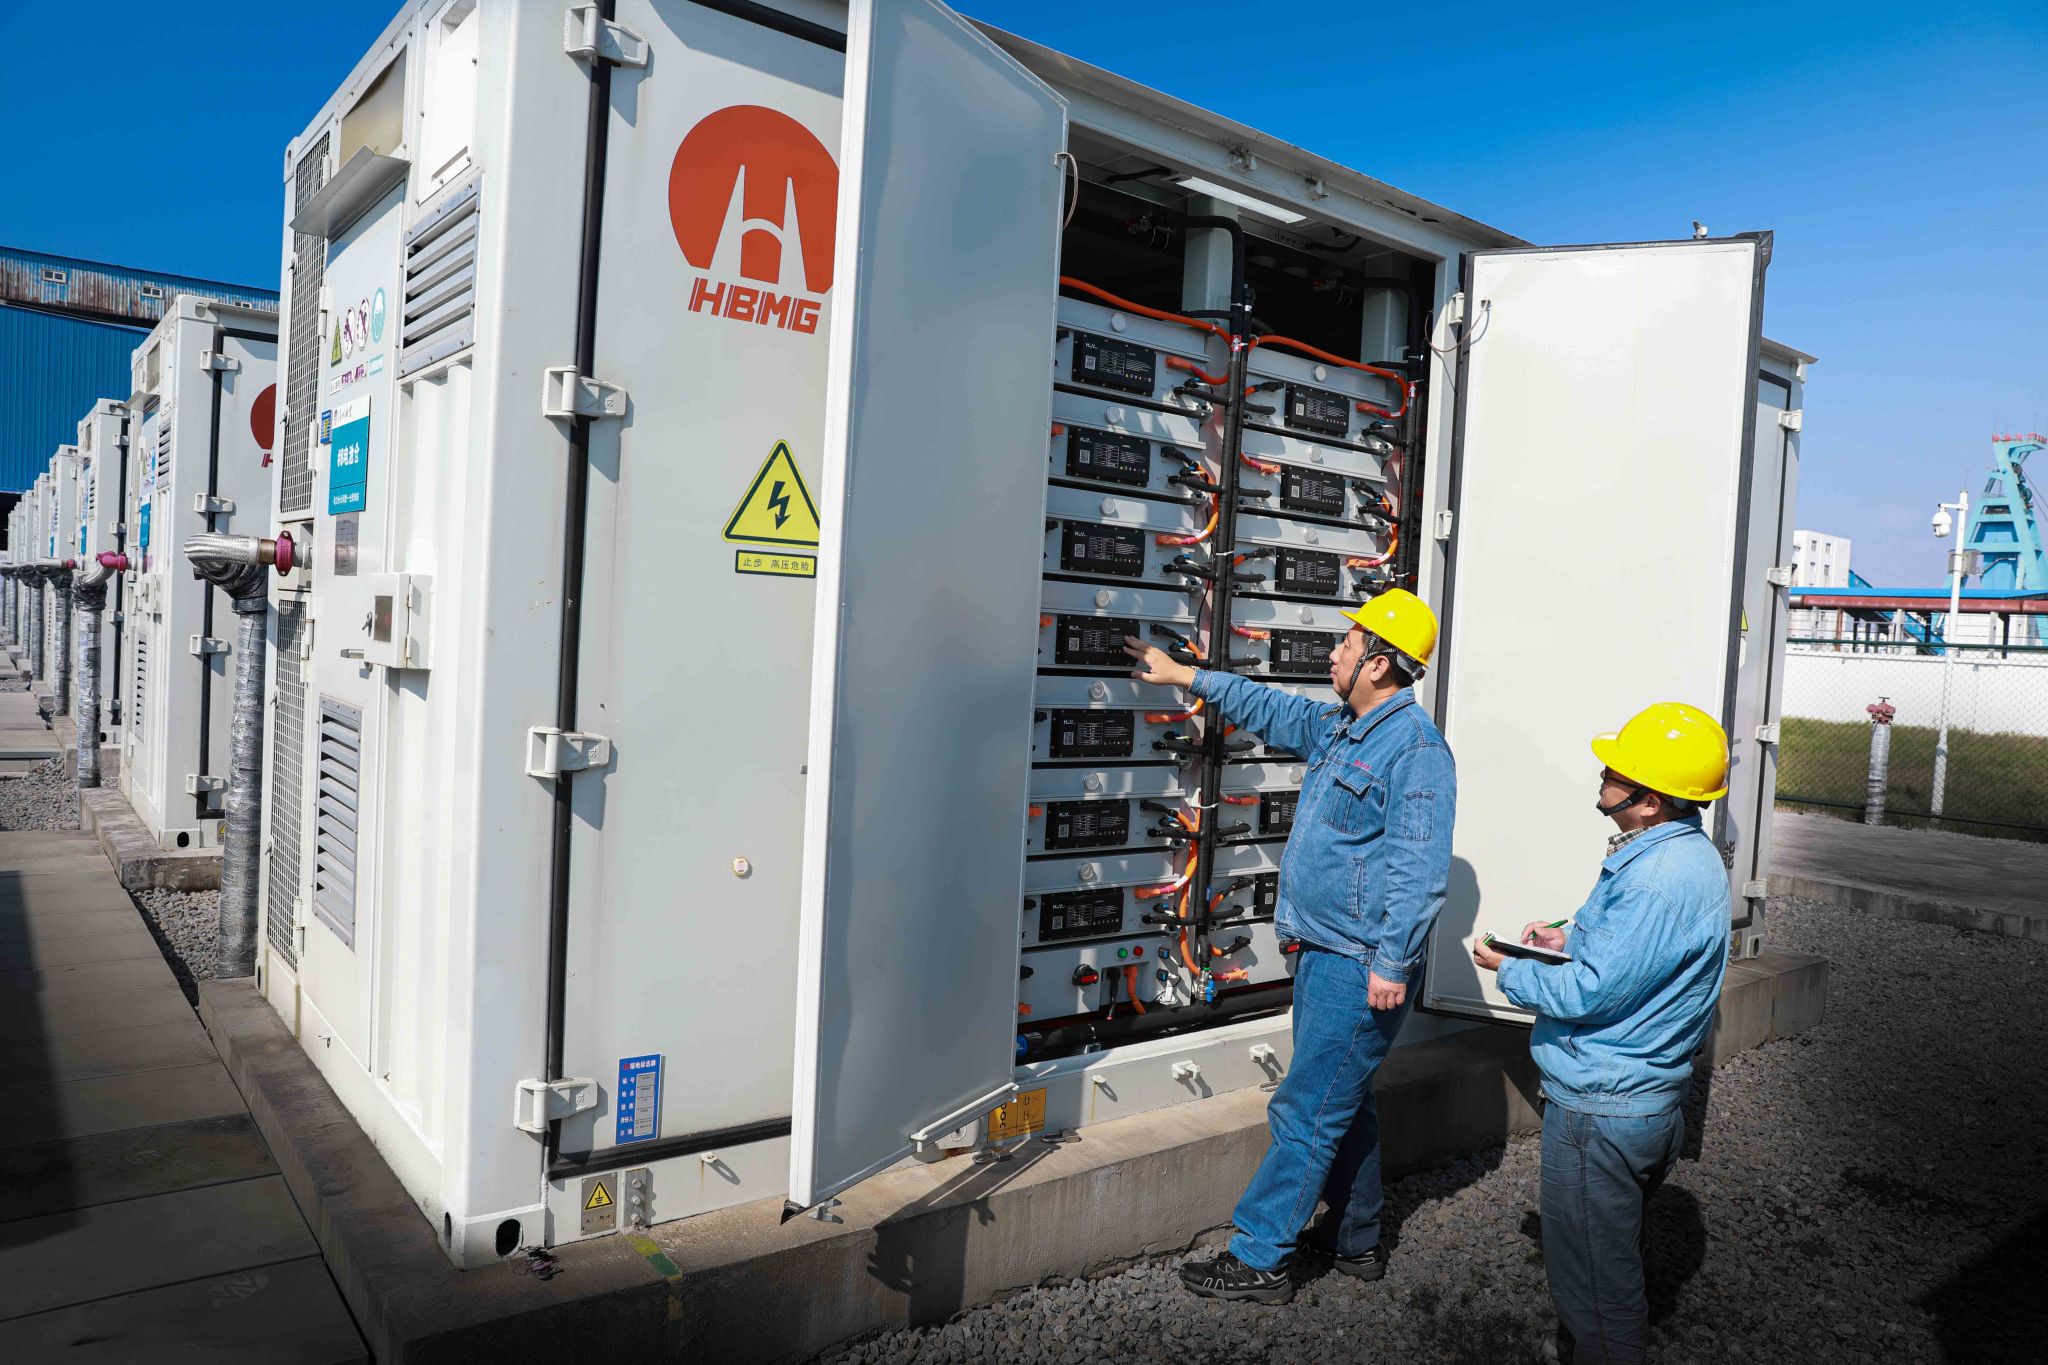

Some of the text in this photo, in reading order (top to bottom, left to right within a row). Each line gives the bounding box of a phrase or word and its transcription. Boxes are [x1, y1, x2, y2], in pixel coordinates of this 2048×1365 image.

[688, 277, 822, 335] HBMG
[743, 558, 810, 572] 止步 高压危险
